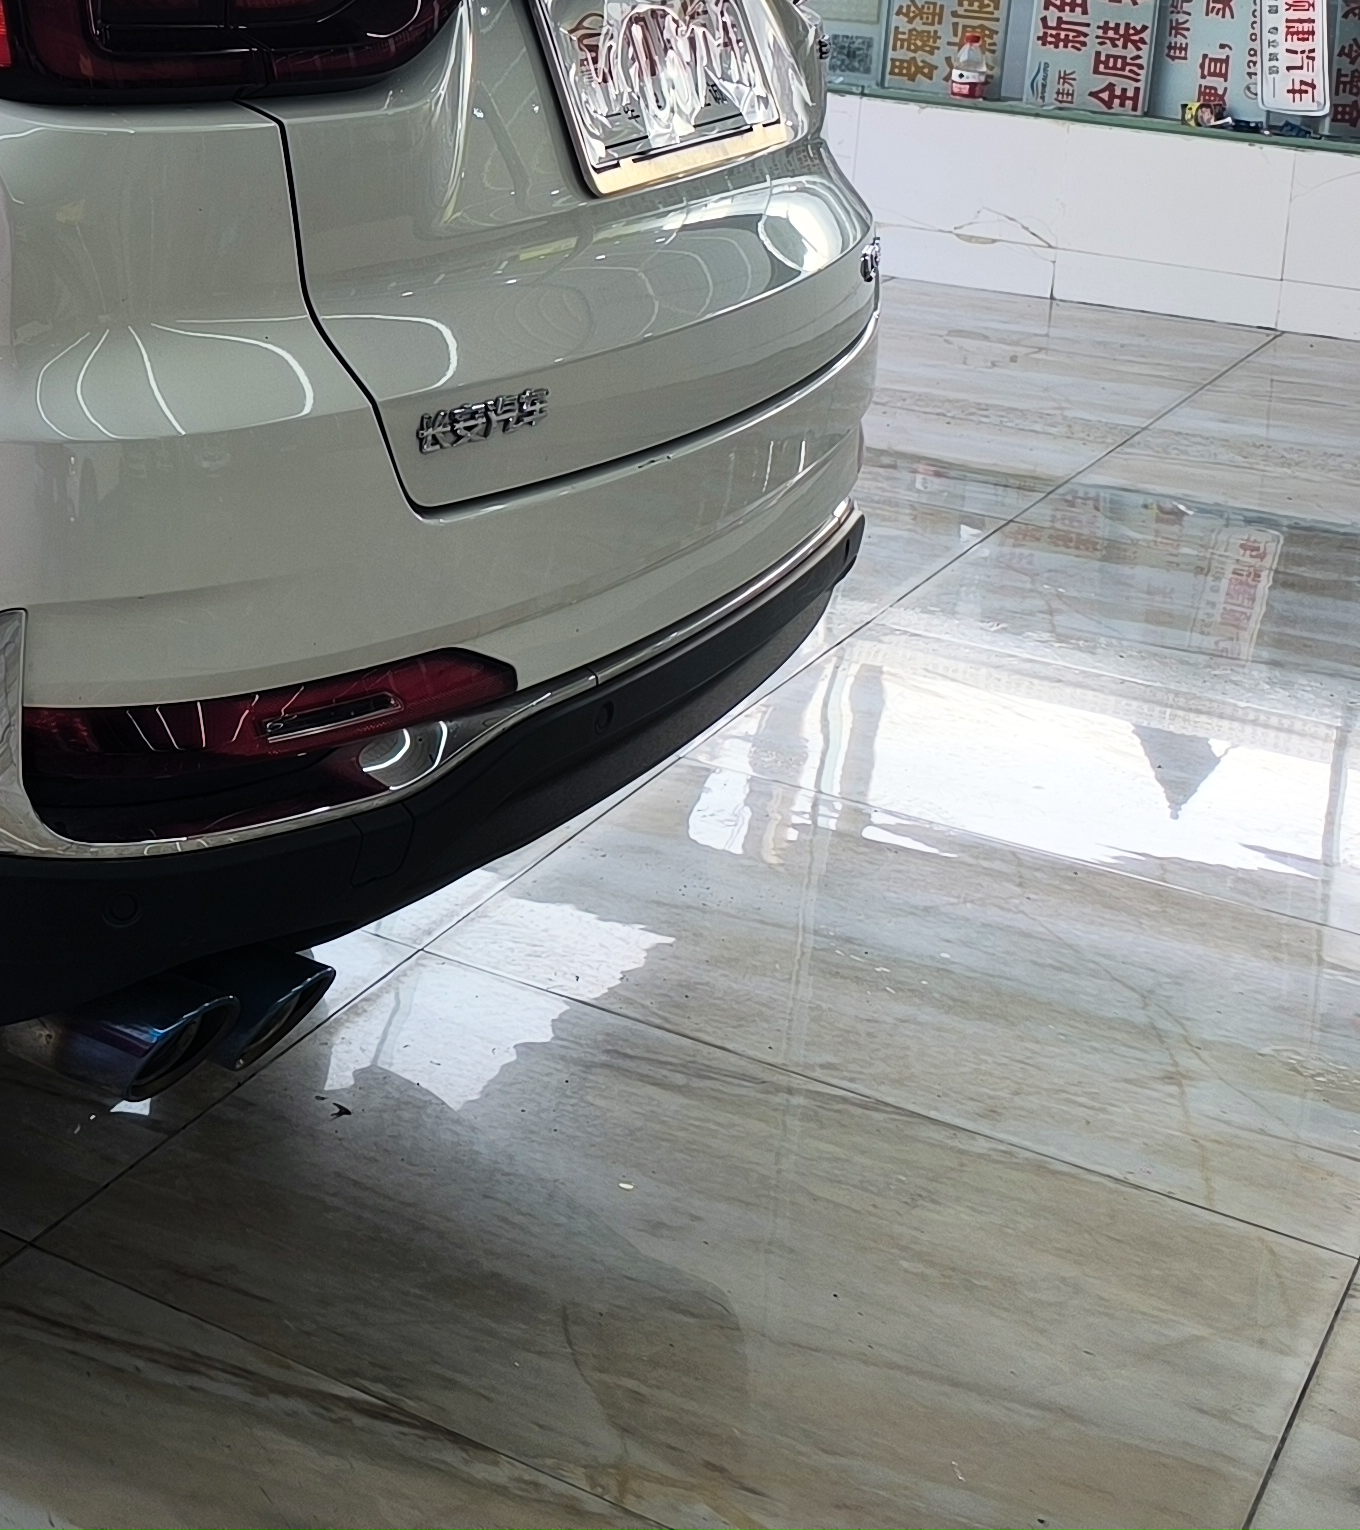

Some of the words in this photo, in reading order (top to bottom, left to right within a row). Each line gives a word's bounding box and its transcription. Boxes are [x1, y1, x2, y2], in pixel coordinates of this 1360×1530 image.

[1053, 69, 1078, 105] 佳禾
[1088, 19, 1150, 113] 全原装
[416, 387, 550, 455] 长安汽车
